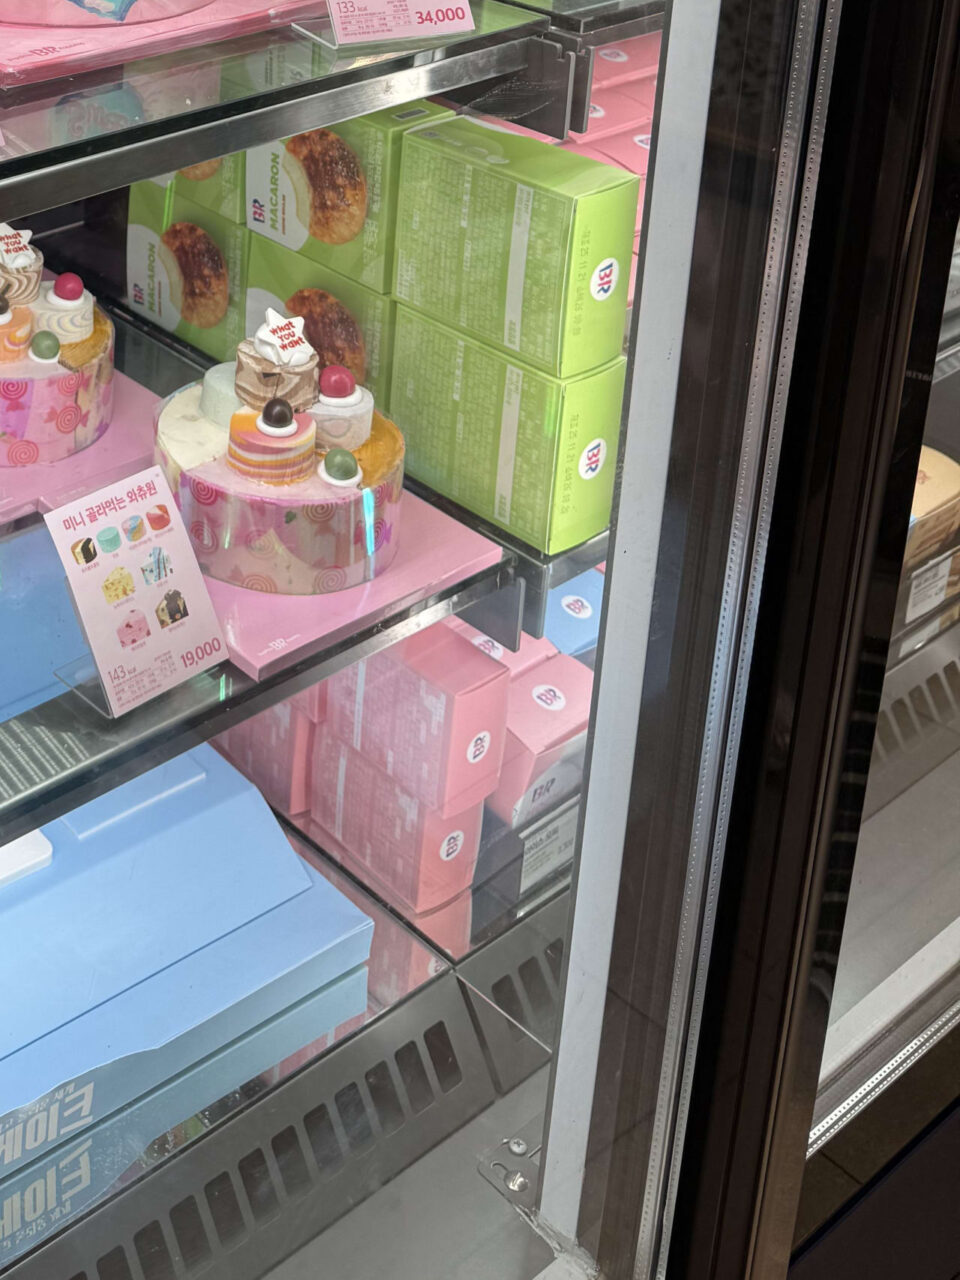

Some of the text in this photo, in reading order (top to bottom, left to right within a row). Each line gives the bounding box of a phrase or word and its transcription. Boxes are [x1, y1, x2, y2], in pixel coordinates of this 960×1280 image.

[336, 1, 356, 14] 133
[415, 6, 466, 26] 34,000
[270, 152, 280, 231] MACARON
[252, 199, 265, 223] BR
[597, 263, 614, 294] BR
[585, 442, 601, 474] BR
[62, 480, 158, 532] 미니 골라먹는 와츄원
[566, 598, 588, 615] BR
[180, 637, 222, 669] 19,000
[108, 665, 127, 684] 143
[536, 687, 562, 706] BR
[472, 735, 487, 759] BR
[532, 777, 556, 802] BR
[446, 835, 461, 857] BR
